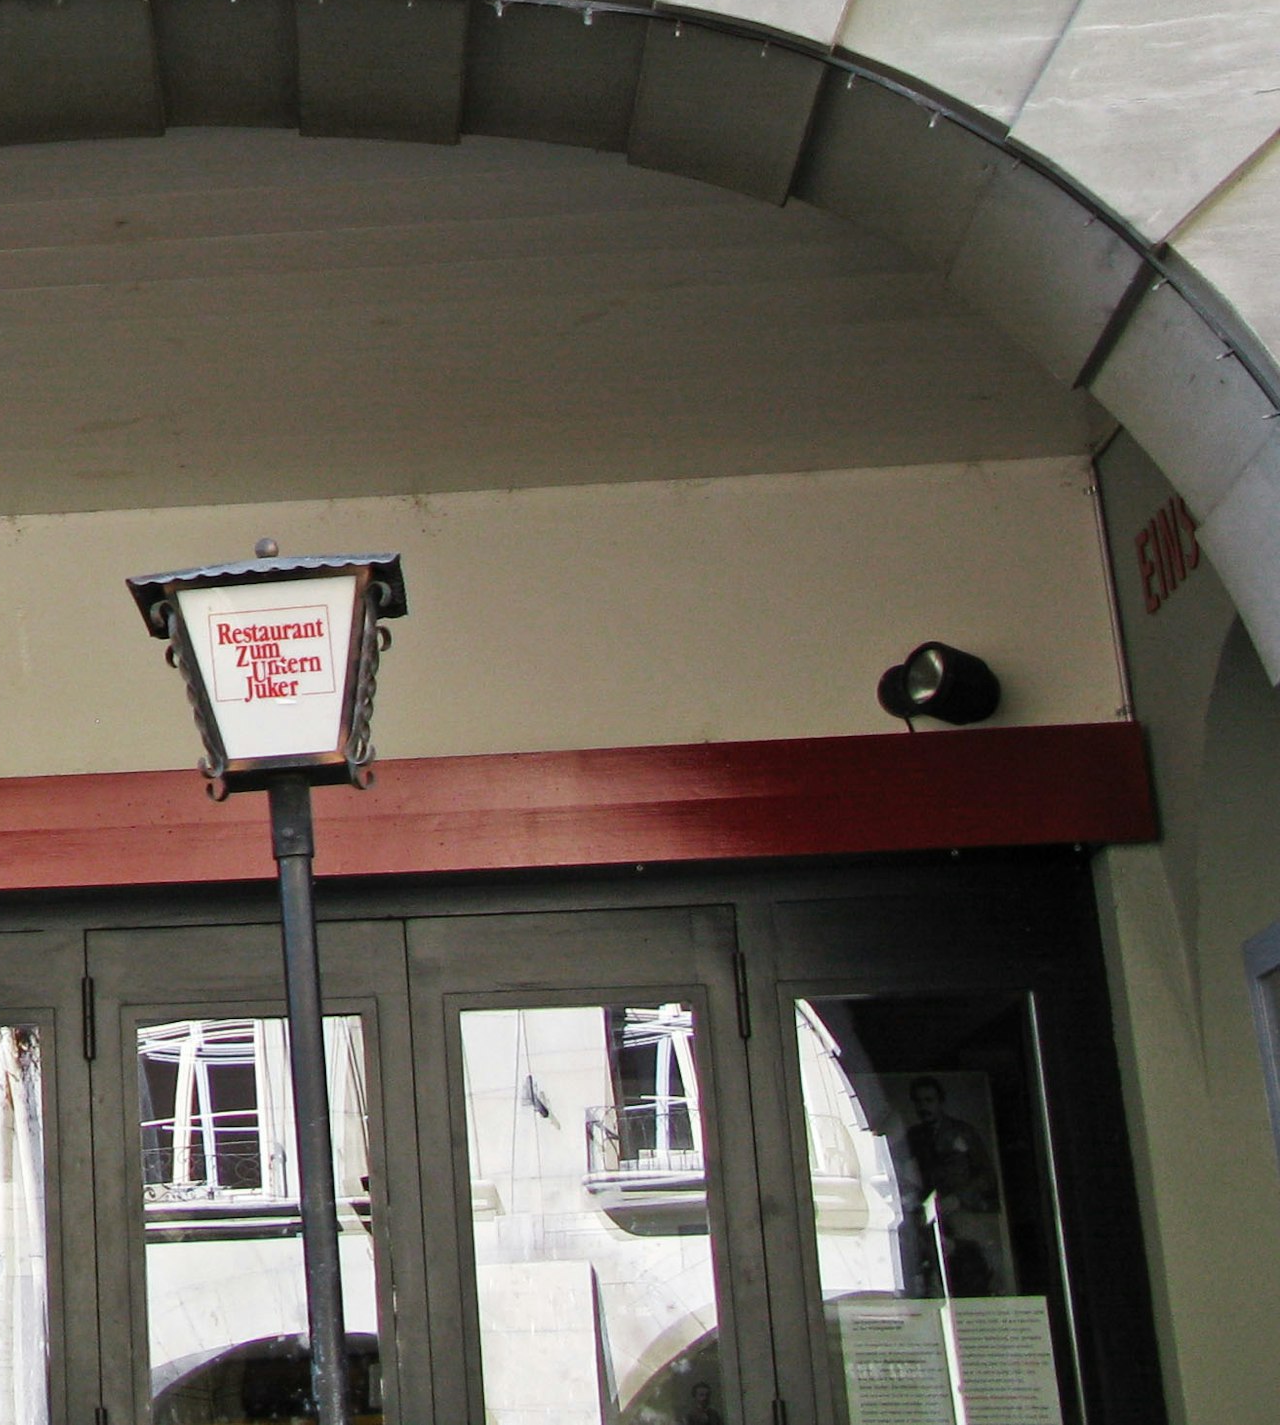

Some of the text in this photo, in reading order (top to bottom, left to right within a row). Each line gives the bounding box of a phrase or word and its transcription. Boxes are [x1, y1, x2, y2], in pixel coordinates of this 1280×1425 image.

[217, 618, 324, 645] Restaurant
[251, 656, 322, 683] Untern
[244, 676, 299, 703] Juker
